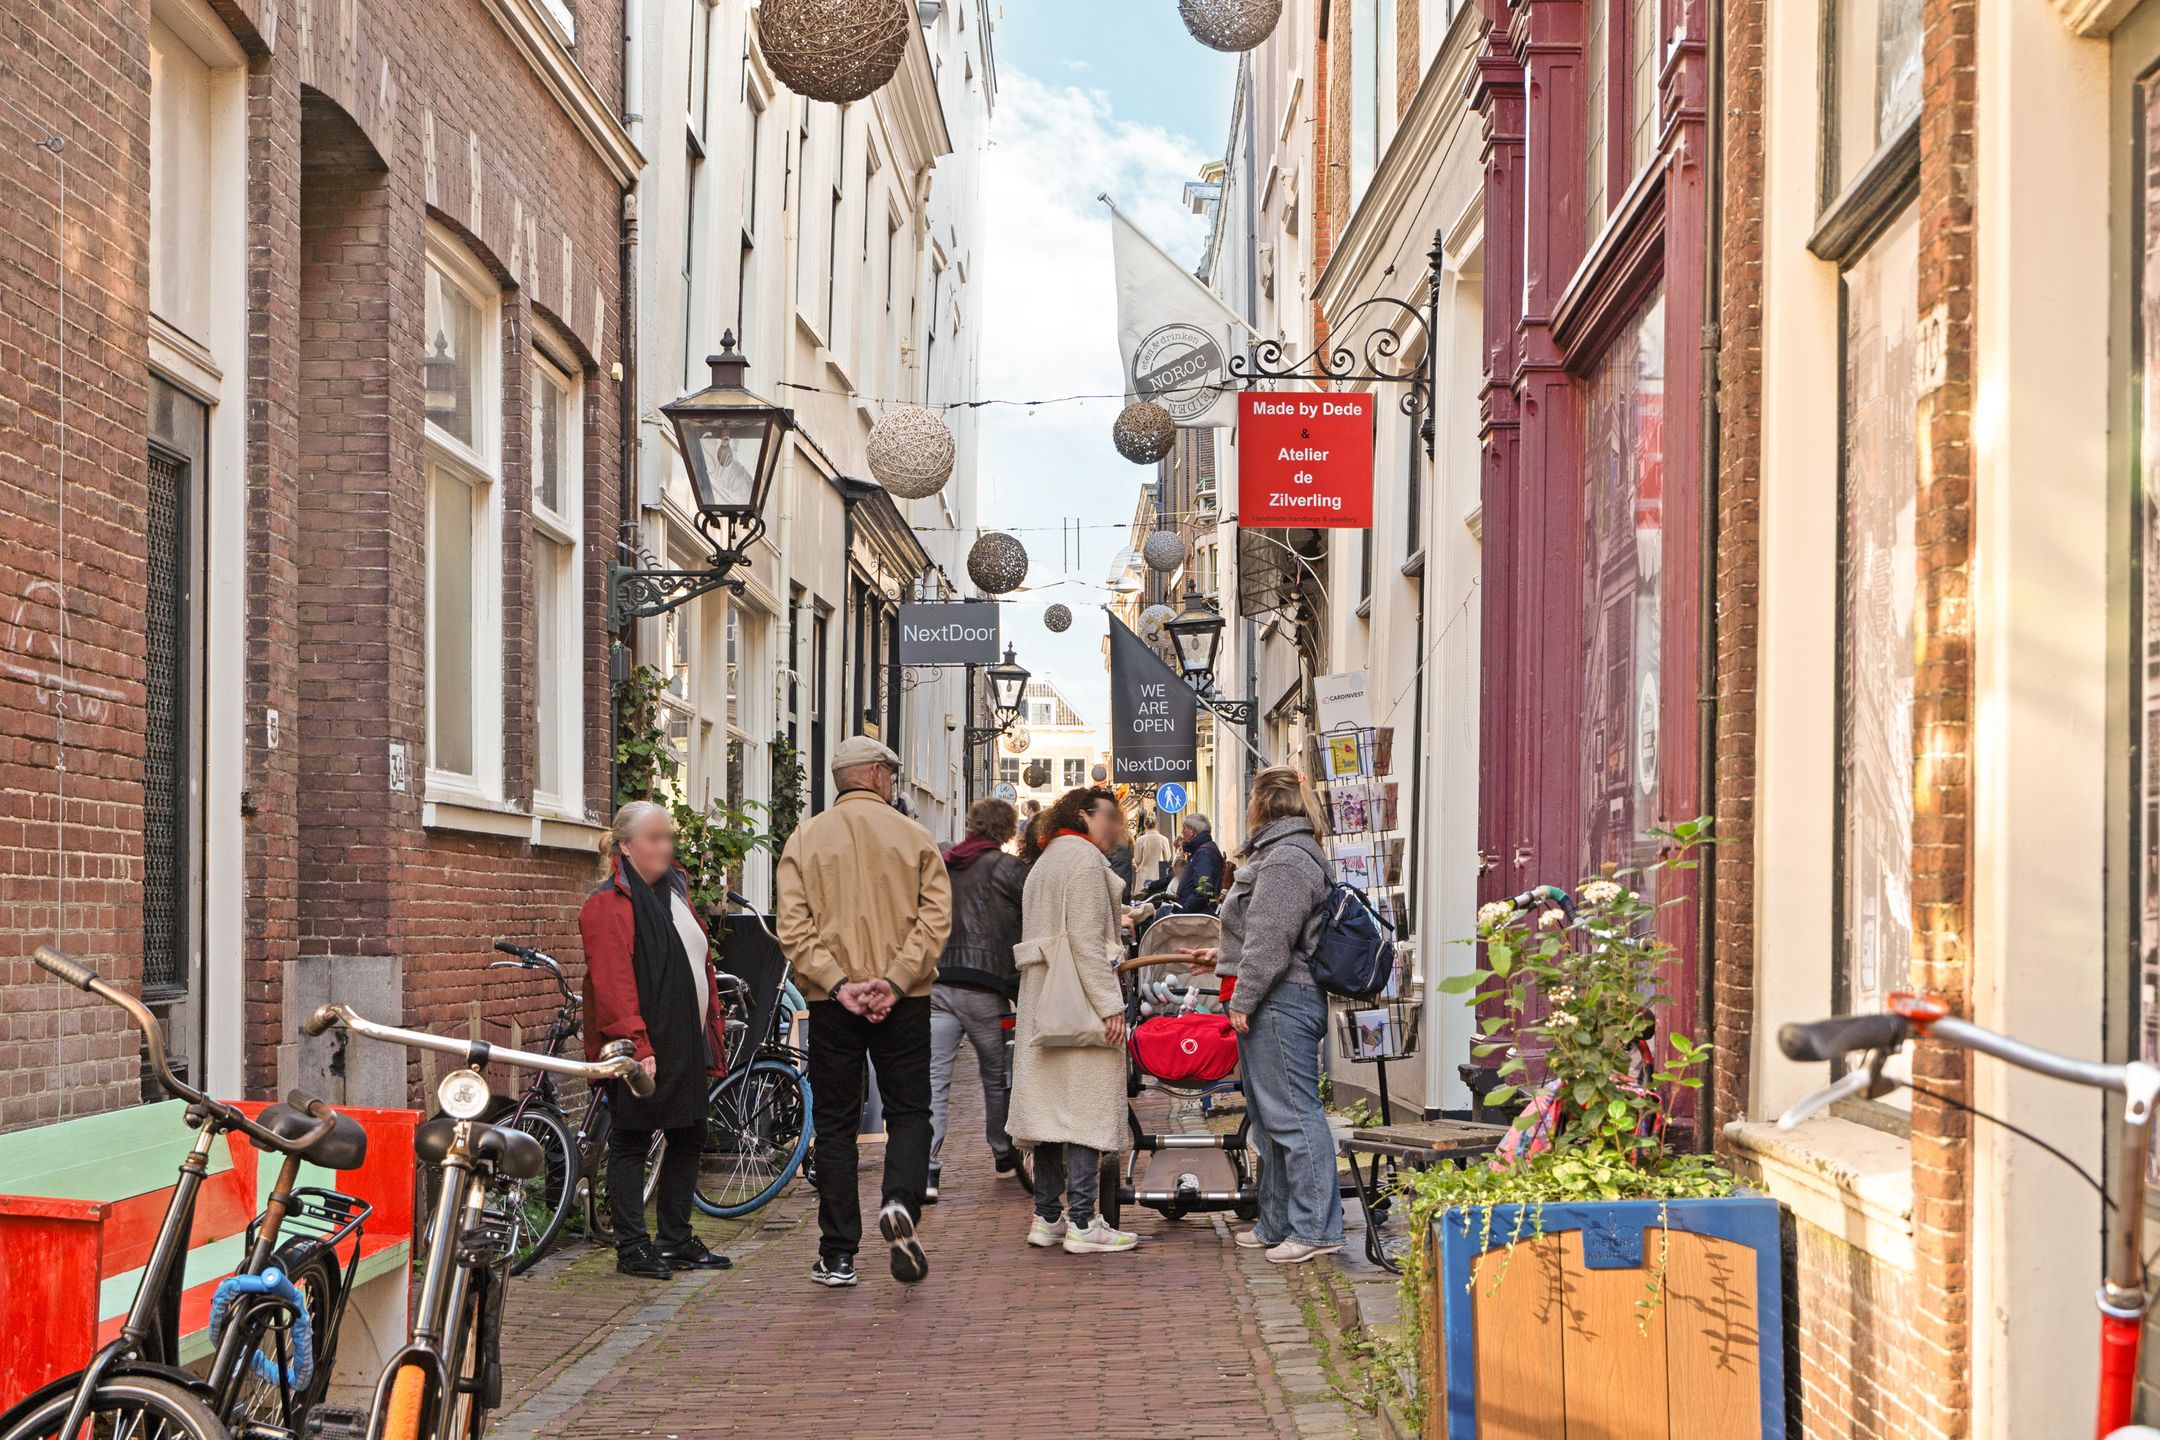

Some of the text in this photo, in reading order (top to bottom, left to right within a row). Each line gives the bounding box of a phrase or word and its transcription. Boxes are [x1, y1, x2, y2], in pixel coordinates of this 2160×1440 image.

[1142, 332, 1199, 370] eten & drinken
[1921, 318, 1939, 382] 10
[1148, 355, 1207, 391] NOROC
[1168, 386, 1212, 414] EIDEN
[1253, 401, 1362, 418] Made by Dede
[1301, 428, 1310, 439] &
[1277, 447, 1329, 461] Atelier
[1293, 470, 1313, 484] de
[1269, 493, 1342, 510] Zilverling
[903, 624, 996, 642] NextDoor
[1140, 684, 1165, 697] WE
[1329, 691, 1364, 702] CARDINVEST
[1138, 702, 1169, 715] ARE
[1133, 719, 1175, 732] OPEN
[1116, 757, 1193, 772] NextDoor
